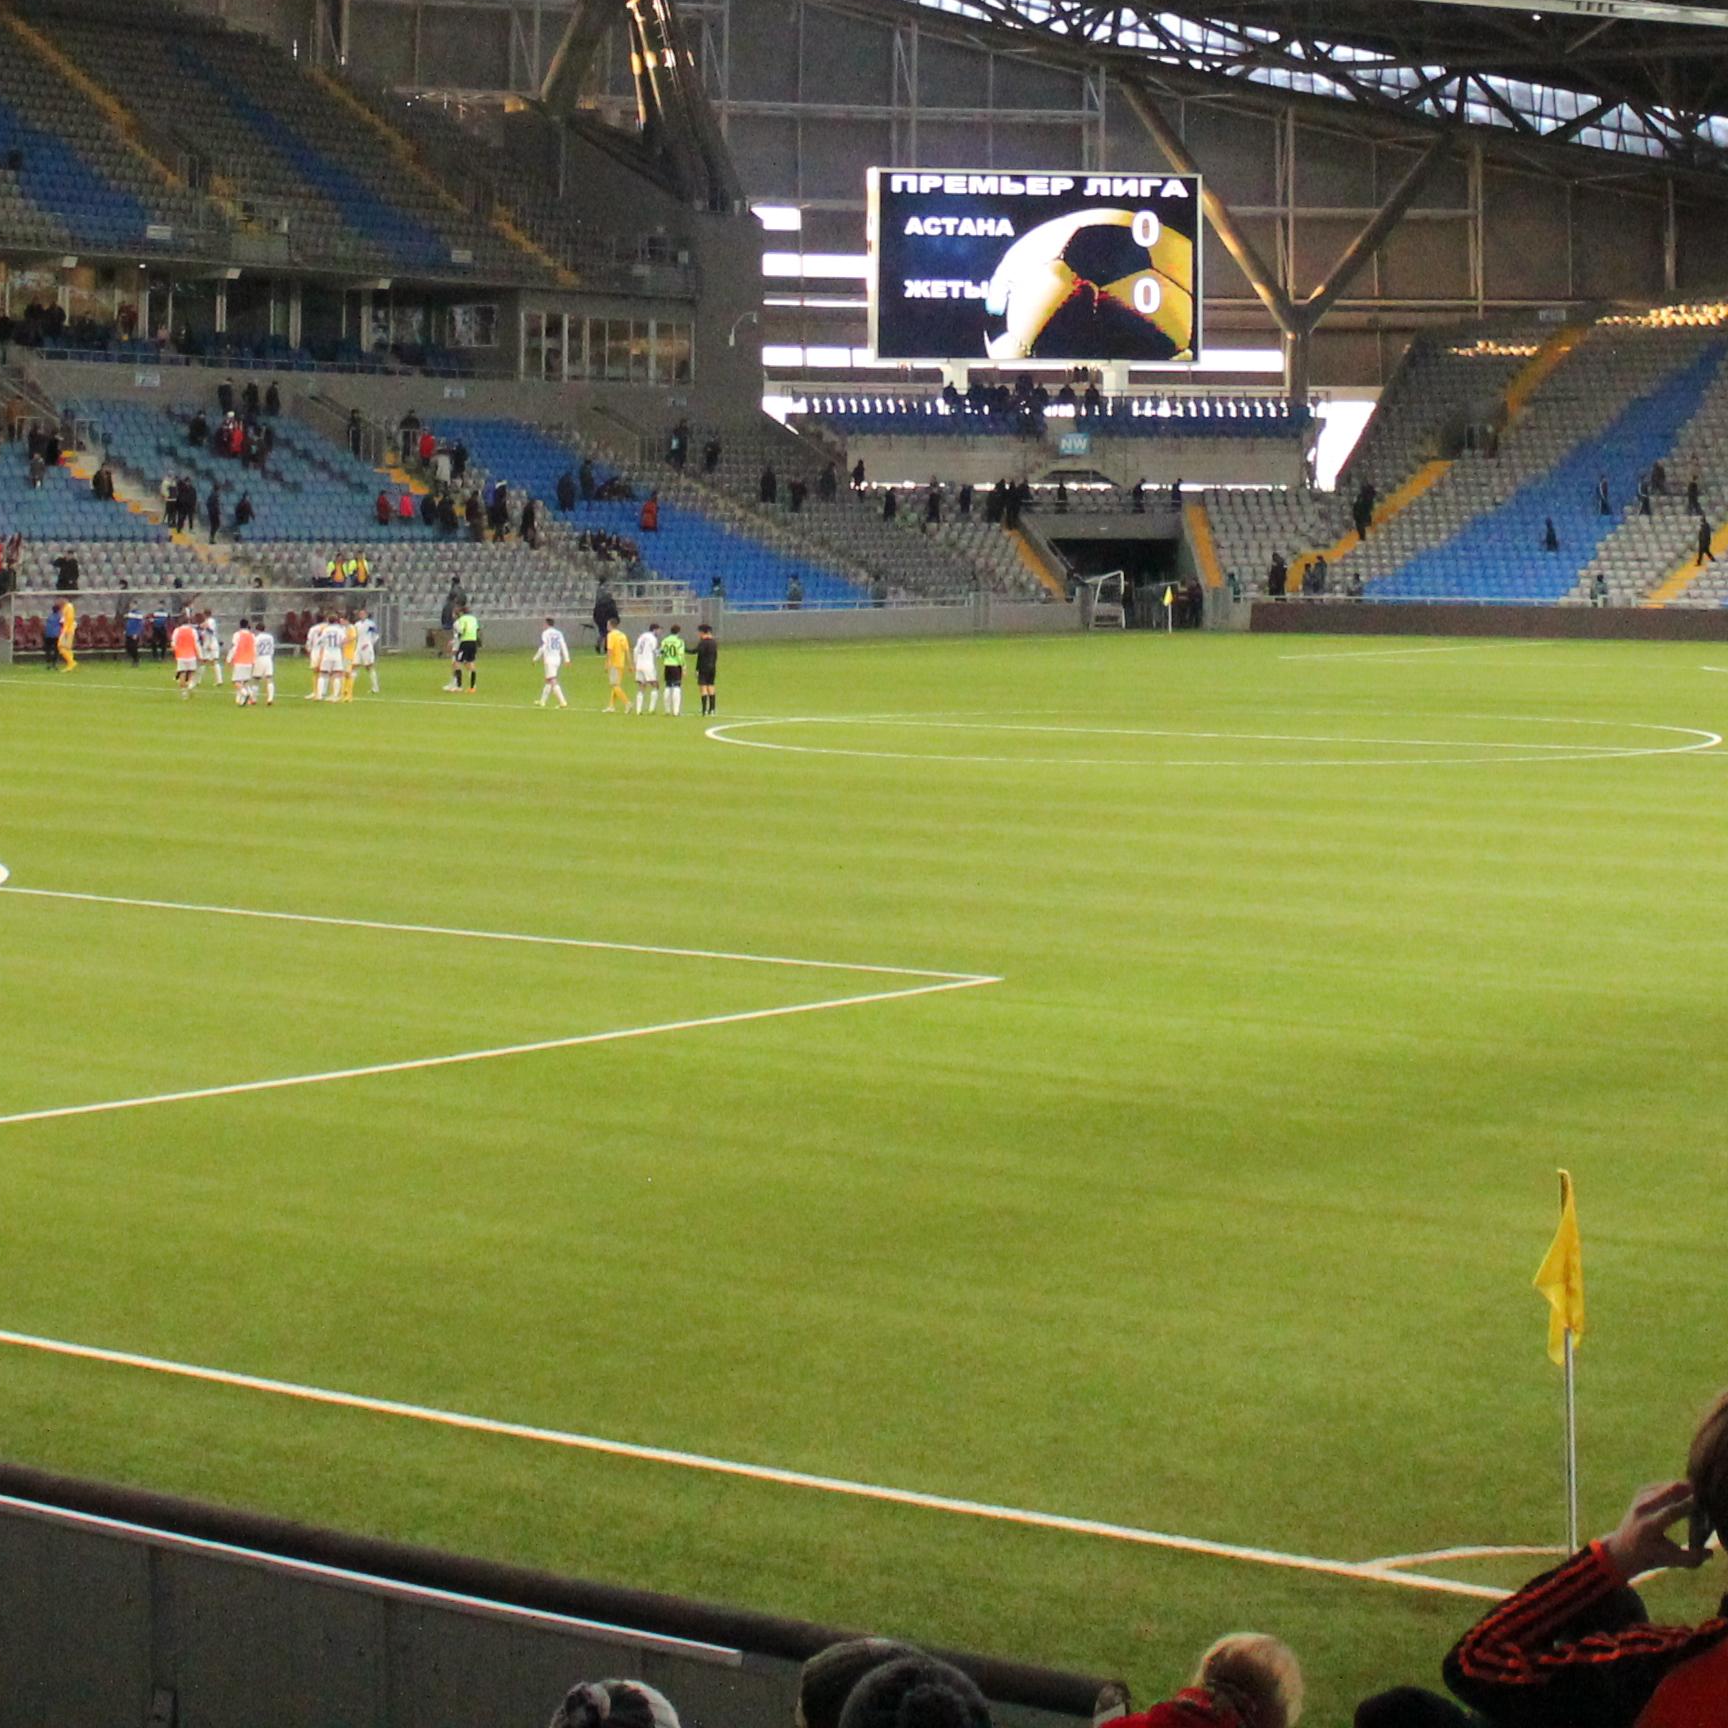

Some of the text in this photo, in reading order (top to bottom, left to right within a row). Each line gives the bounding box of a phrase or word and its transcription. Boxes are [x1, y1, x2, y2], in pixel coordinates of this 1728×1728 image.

[891, 174, 1189, 198] ПРЕМЬЕР ЛИГА
[904, 210, 1160, 248] АСТАНА 0
[1134, 277, 1161, 314] 0
[1061, 437, 1087, 450] NW
[663, 644, 677, 658] 20
